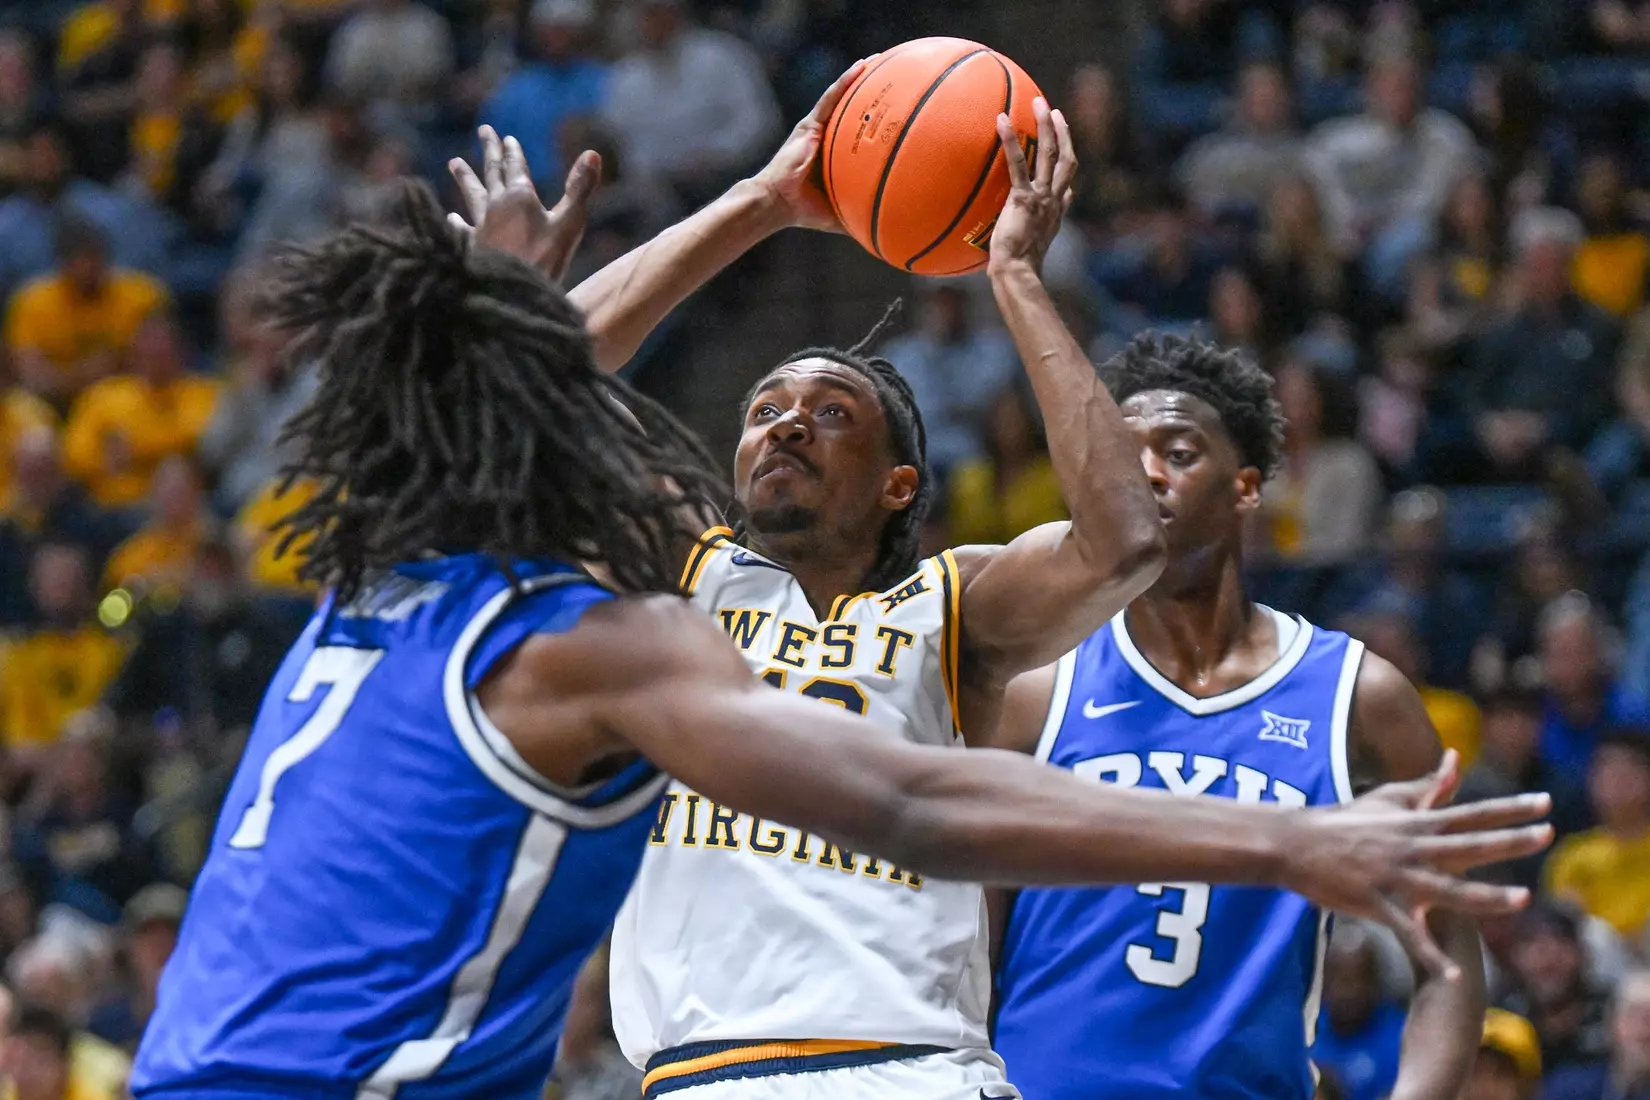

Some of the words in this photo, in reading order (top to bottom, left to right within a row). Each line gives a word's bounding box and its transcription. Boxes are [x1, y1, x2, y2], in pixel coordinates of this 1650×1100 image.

[719, 608, 916, 678] WEST
[228, 646, 386, 849] 7
[650, 792, 922, 889] VIRGIN
[1125, 883, 1211, 988] 3
